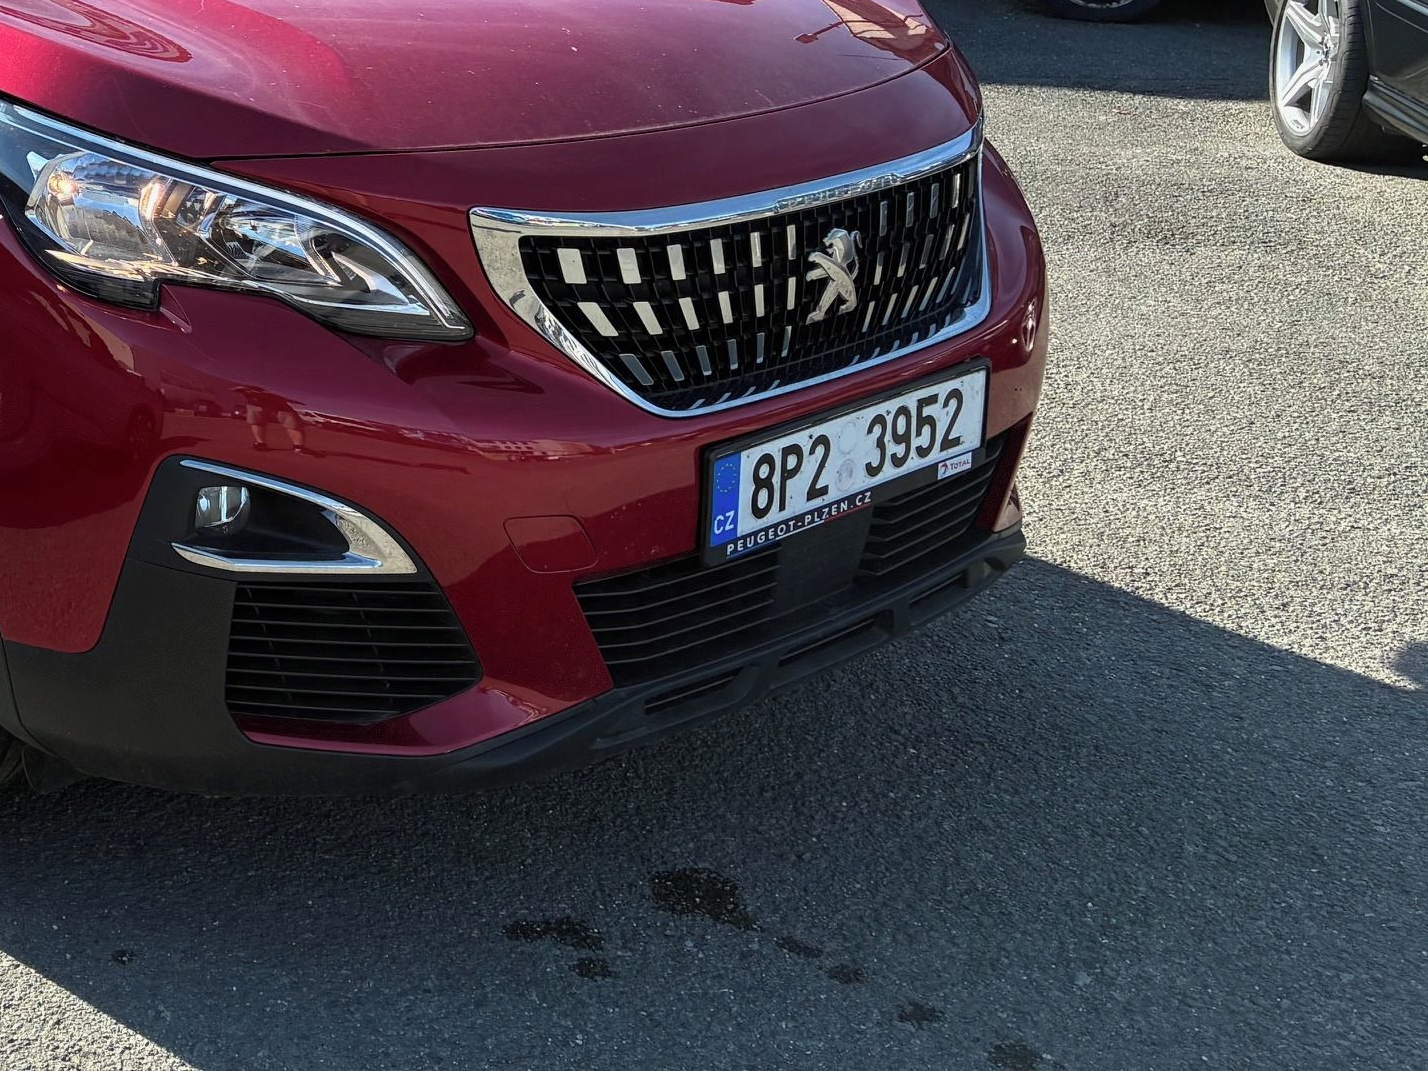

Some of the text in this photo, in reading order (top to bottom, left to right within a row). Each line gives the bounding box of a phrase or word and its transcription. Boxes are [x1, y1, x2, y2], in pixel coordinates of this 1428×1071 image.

[750, 387, 964, 520] 8P2 3952
[949, 459, 971, 470] TOTAL
[713, 510, 735, 535] CZ
[726, 491, 872, 556] PEUGEOT-PLZEN.CZ
